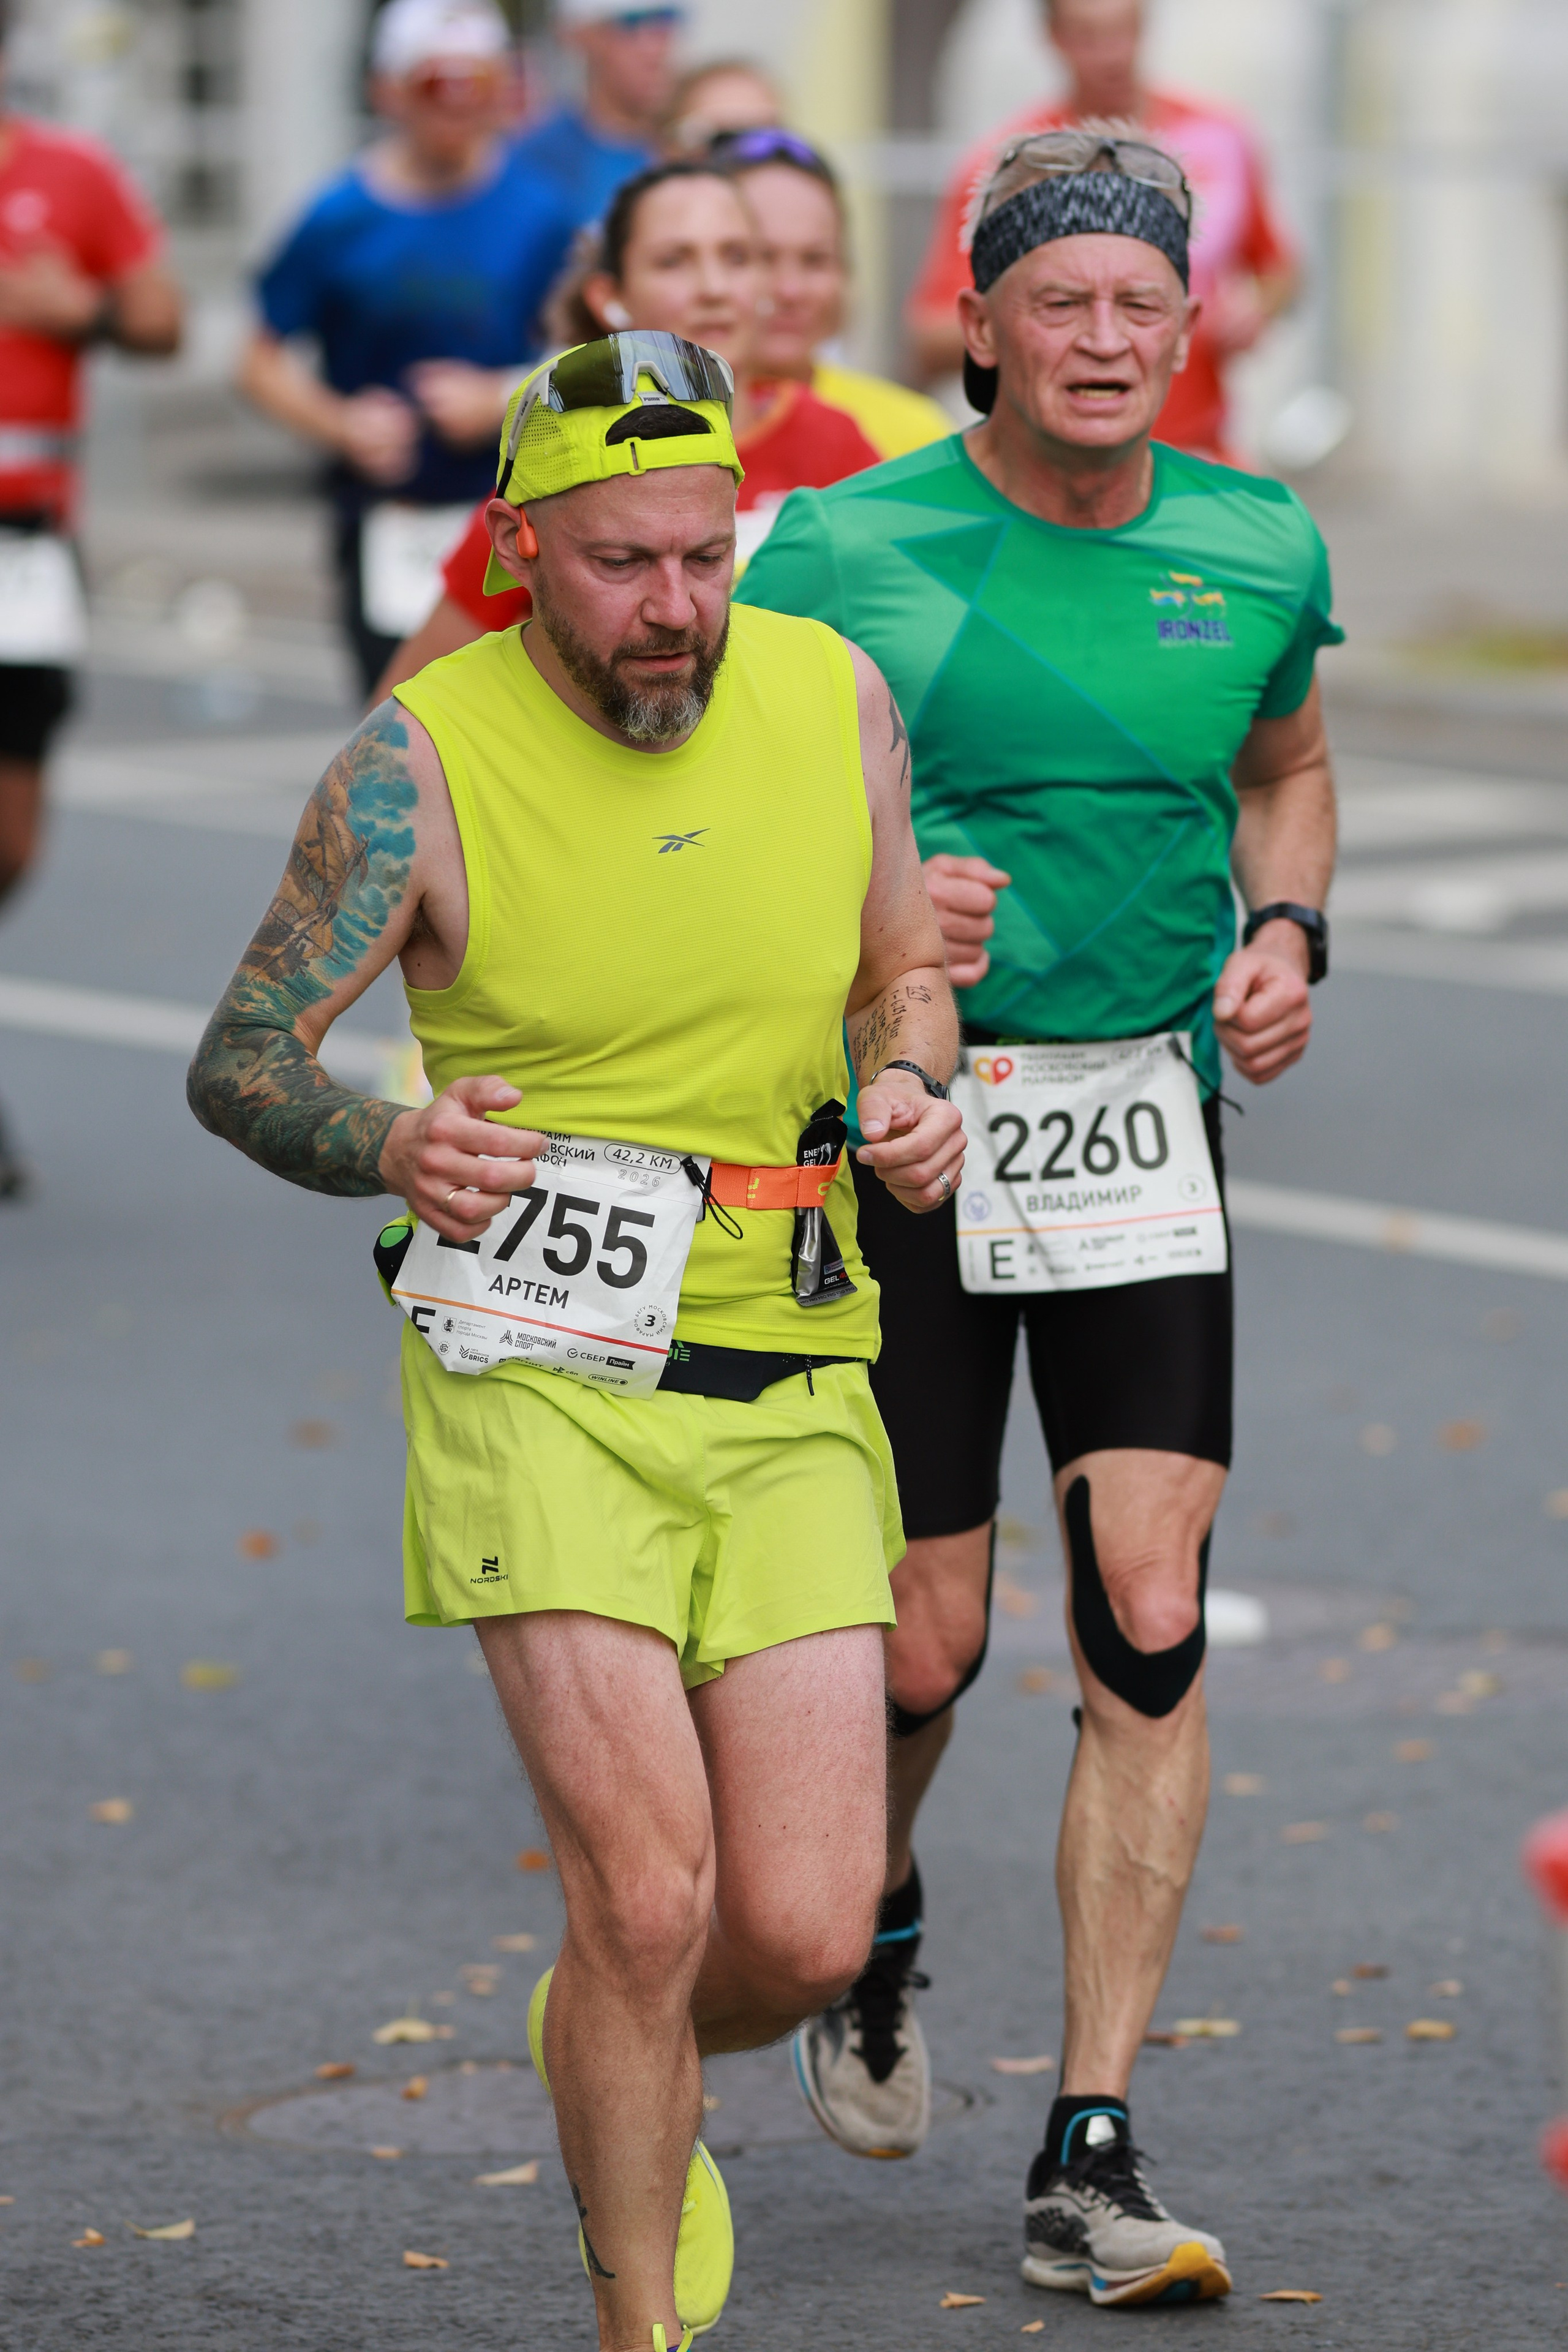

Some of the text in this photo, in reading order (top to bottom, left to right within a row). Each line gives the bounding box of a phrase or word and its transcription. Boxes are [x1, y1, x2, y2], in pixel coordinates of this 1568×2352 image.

[988, 1100, 1169, 1182] 2260
[551, 1142, 595, 1161] ВСКИЙ
[612, 1148, 645, 1164] 42,2
[617, 1169, 661, 1187] 2026
[1026, 1185, 1142, 1212] ВЛАДИМИР
[437, 1186, 655, 1289] 755
[989, 1240, 1016, 1280] E
[488, 1274, 570, 1309] АРТЕМ
[458, 1319, 486, 1329] Департамент
[633, 1305, 667, 1337] БЕГУ МОСКОВСКИЙ МАРАФОН
[644, 1314, 656, 1327] 3
[514, 1340, 535, 1351] СПОРТ
[516, 1332, 557, 1349] МОСКОВСКИЙ
[469, 1354, 489, 1363] BRICS
[580, 1352, 630, 1367] СБЕР Прайм
[591, 1375, 619, 1384] WINLINE
[470, 1574, 508, 1584] NORDSKI
